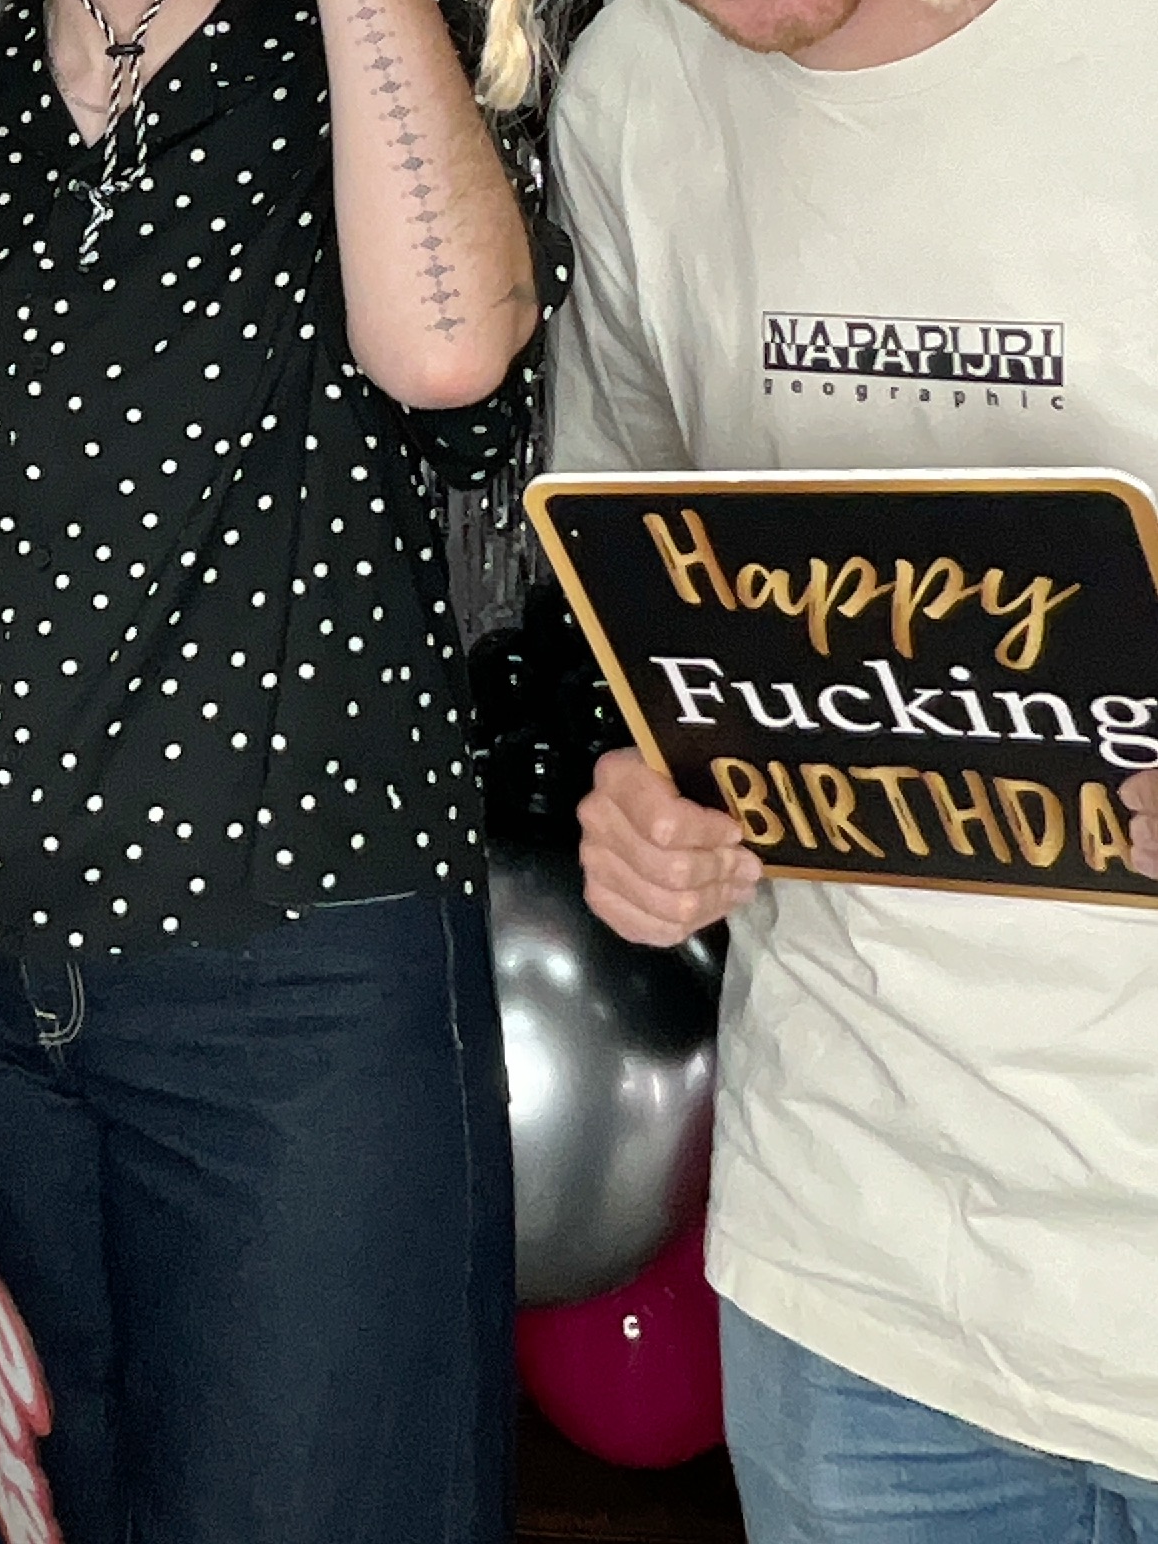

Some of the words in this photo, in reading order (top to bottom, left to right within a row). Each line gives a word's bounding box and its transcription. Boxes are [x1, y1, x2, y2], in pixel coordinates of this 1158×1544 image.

[763, 378, 1066, 411] geographic
[766, 317, 1057, 381] NAPAPIJRI
[643, 509, 1081, 670] Happy
[650, 656, 1158, 770] Fucking
[710, 757, 1134, 873] BIRTHDA
